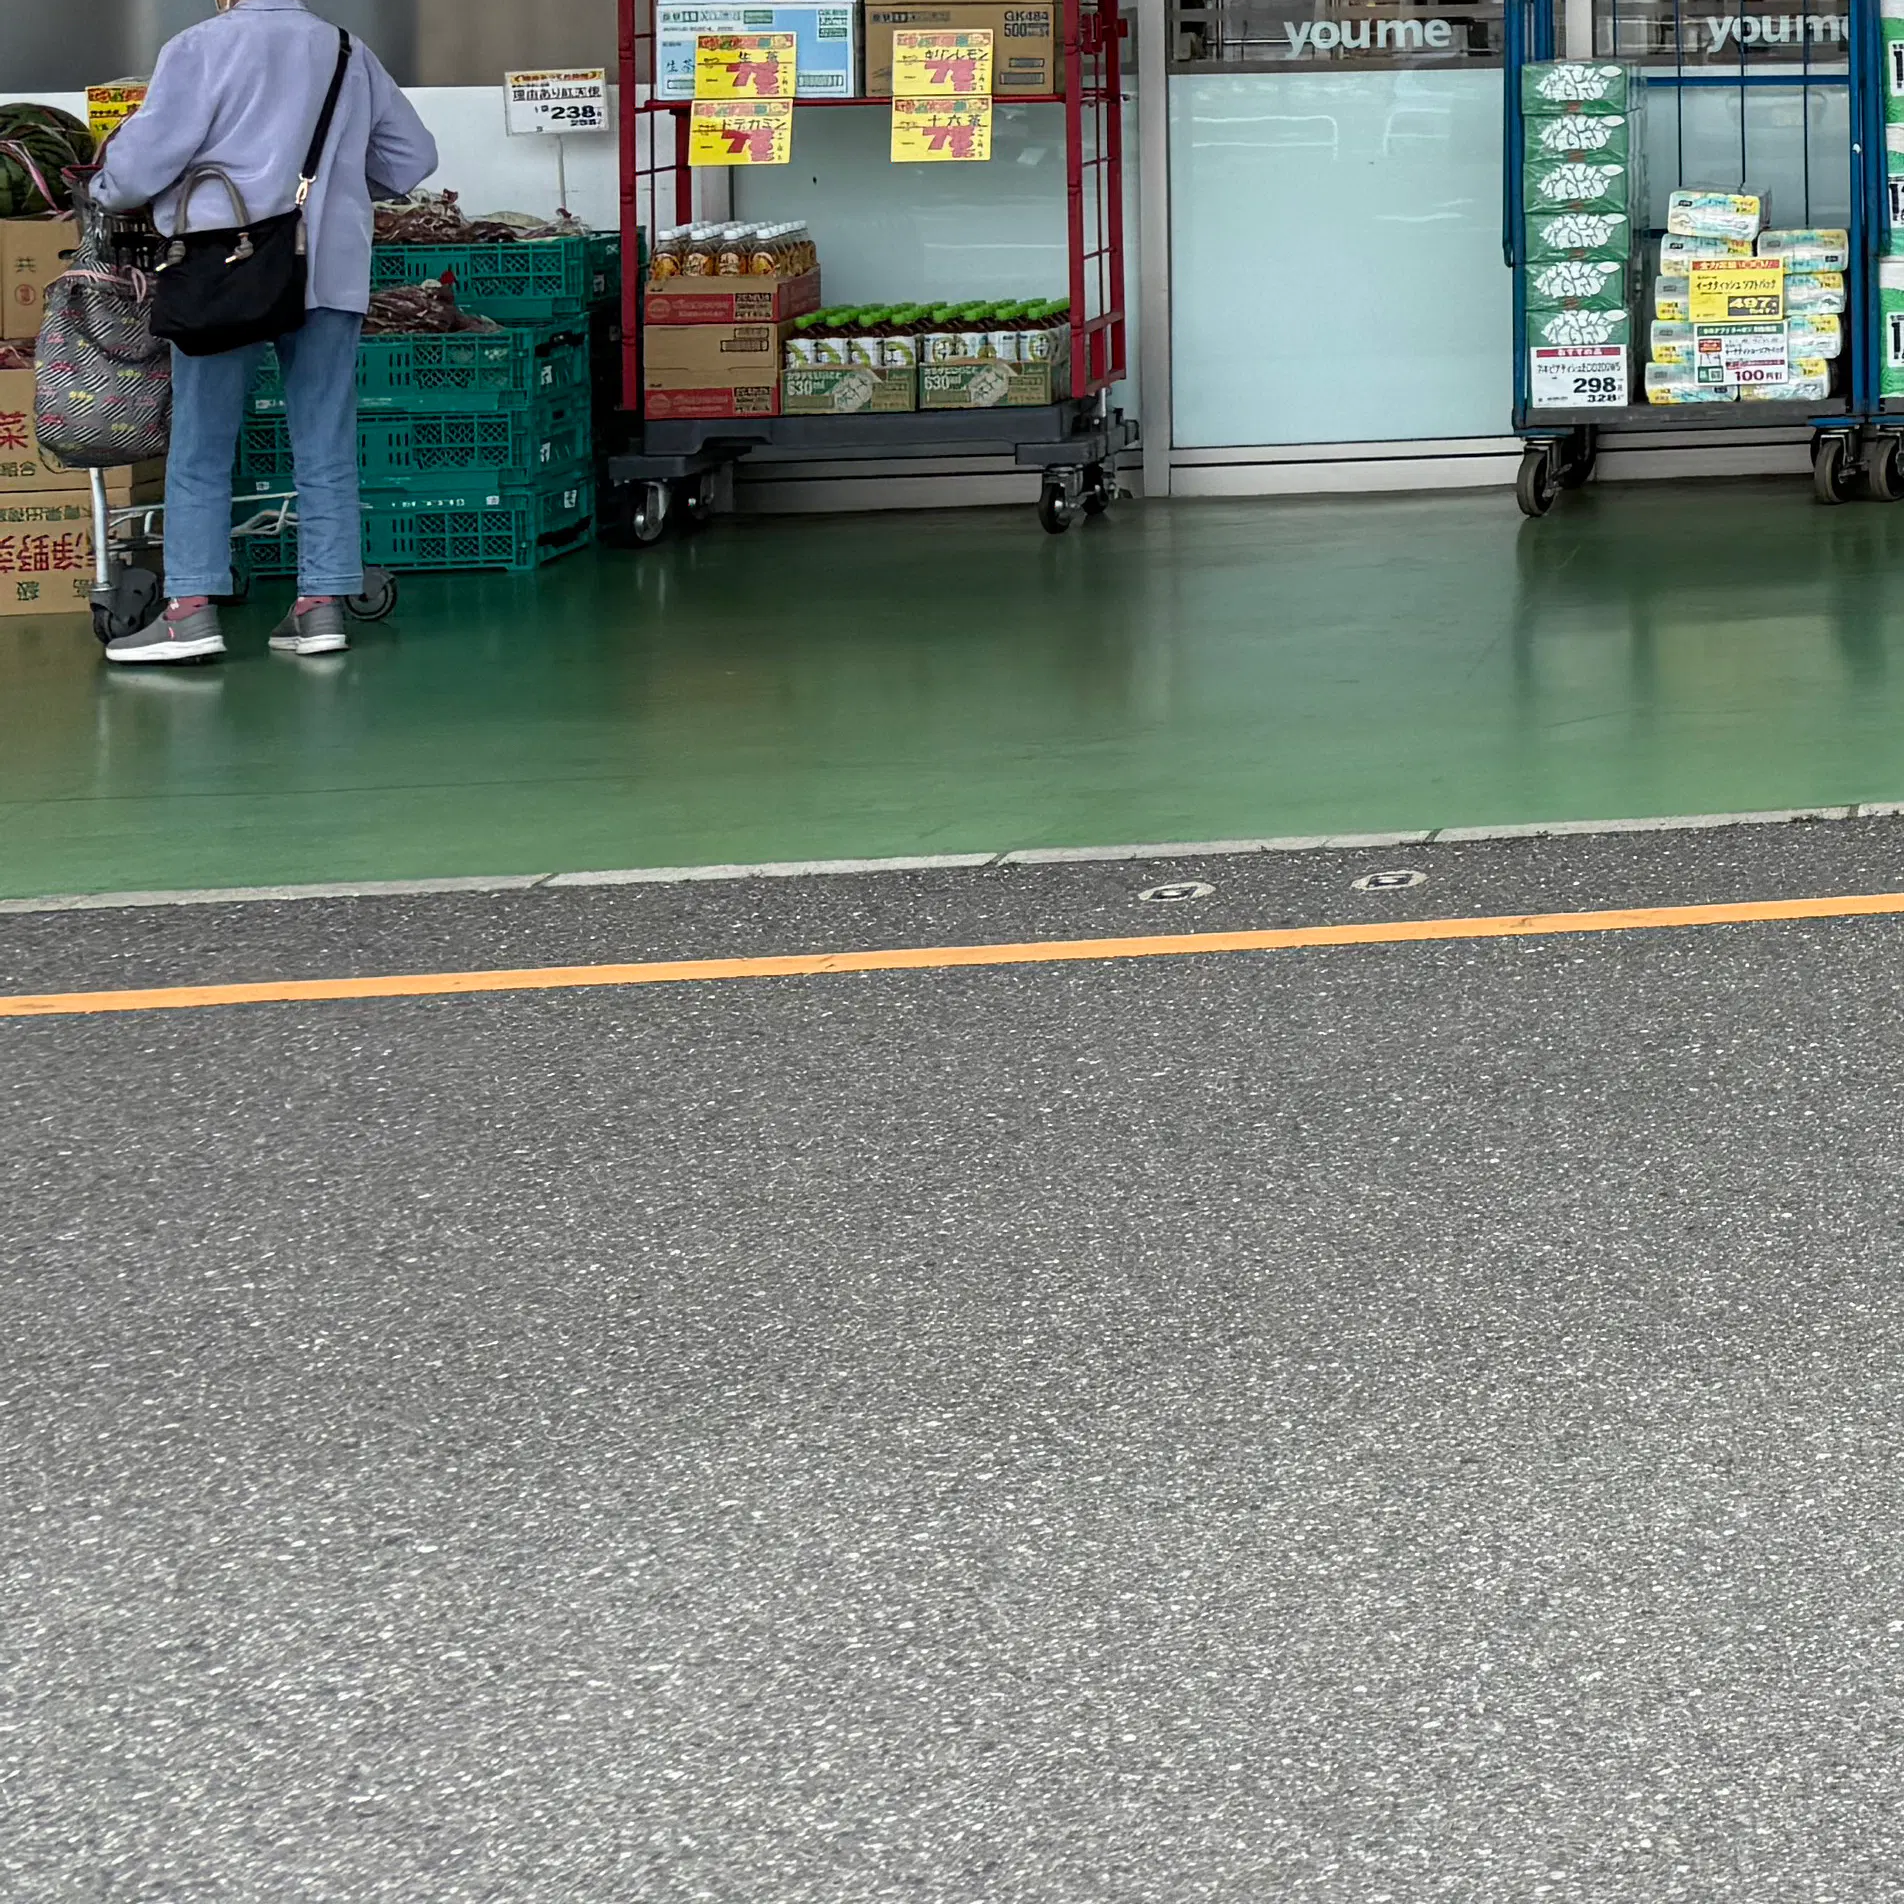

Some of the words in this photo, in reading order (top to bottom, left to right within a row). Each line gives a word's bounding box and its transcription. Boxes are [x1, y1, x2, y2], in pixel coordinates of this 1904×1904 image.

[1283, 17, 1453, 61] youme
[551, 105, 596, 120] 238
[1573, 376, 1617, 394] 298
